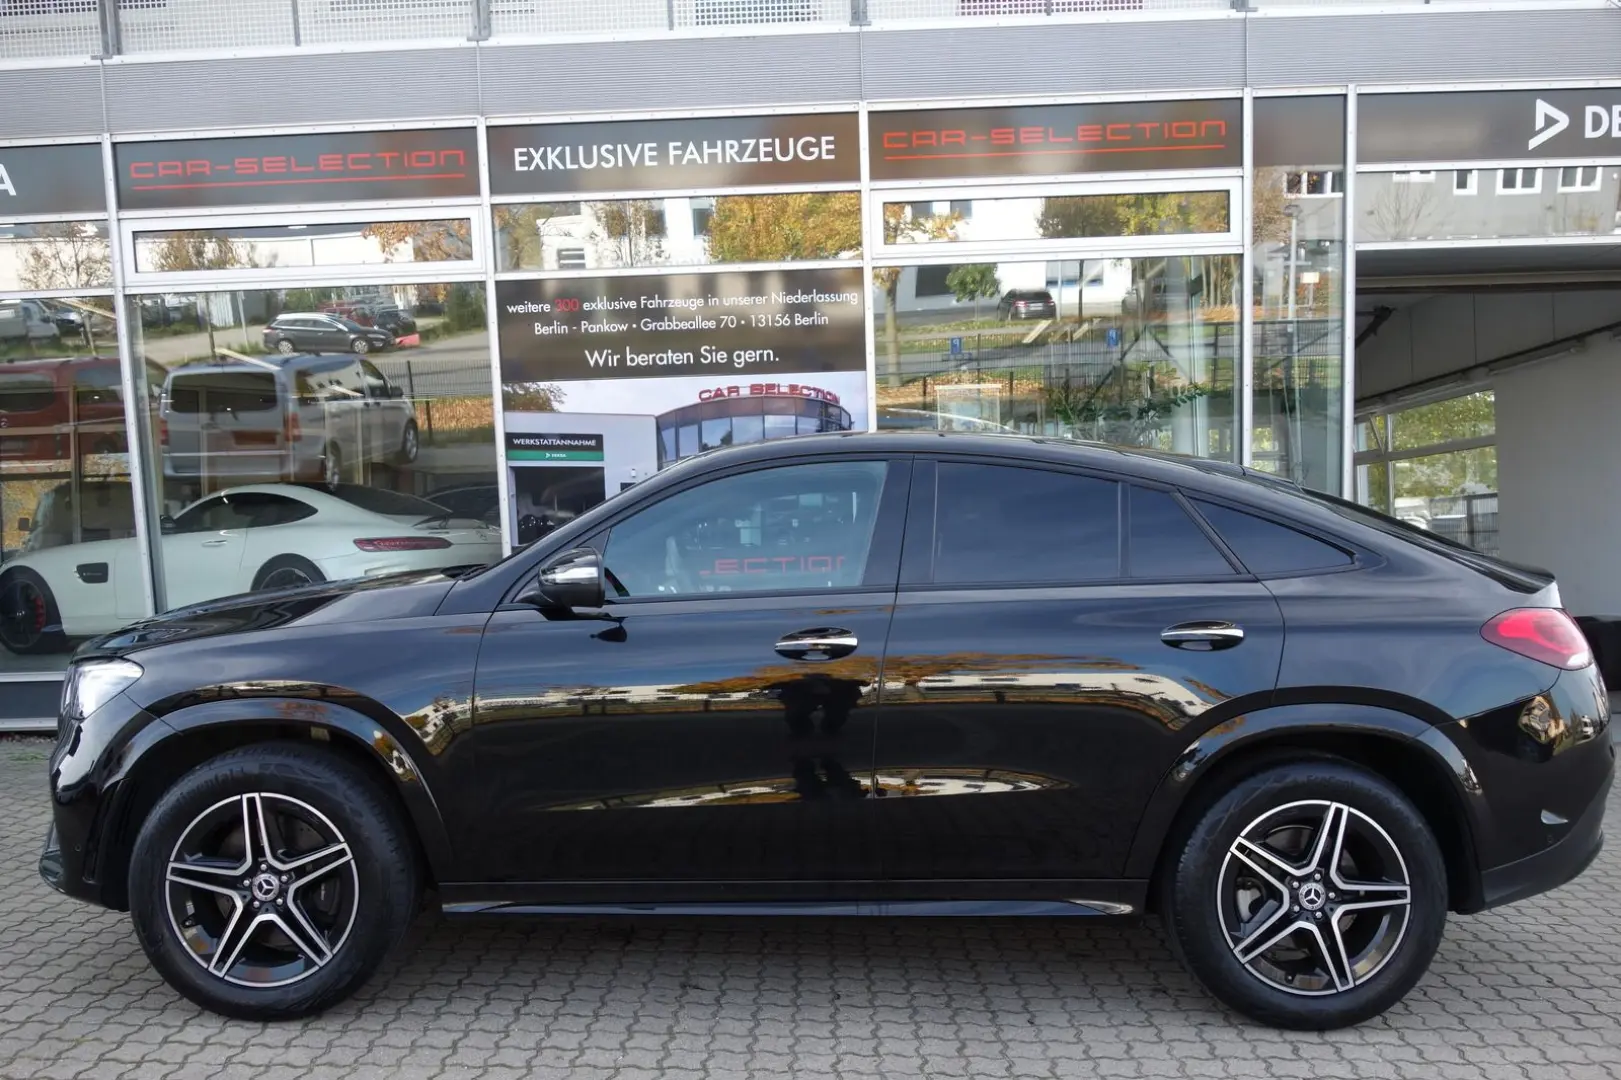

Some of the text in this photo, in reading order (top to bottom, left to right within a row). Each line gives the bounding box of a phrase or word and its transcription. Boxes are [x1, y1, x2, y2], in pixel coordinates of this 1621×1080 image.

[883, 120, 1226, 149] CAR-SELECTION
[129, 150, 466, 179] CAR-SELECTION
[514, 135, 836, 171] EXKLUSIVE FAHRZEUGE
[507, 290, 859, 314] weitere 300 exklusive Fahrzeuge in unserer Niederlassung
[534, 321, 568, 335] Berlin
[581, 320, 628, 333] Pankow
[640, 317, 716, 331] Grabbeallee
[720, 315, 737, 329] 70
[750, 314, 791, 328] 13156
[795, 312, 829, 326] Berlin
[585, 346, 779, 368] Wir beraten Sie gern.
[698, 386, 740, 402] CAR
[512, 438, 597, 446] WERKSTATTANNAHME
